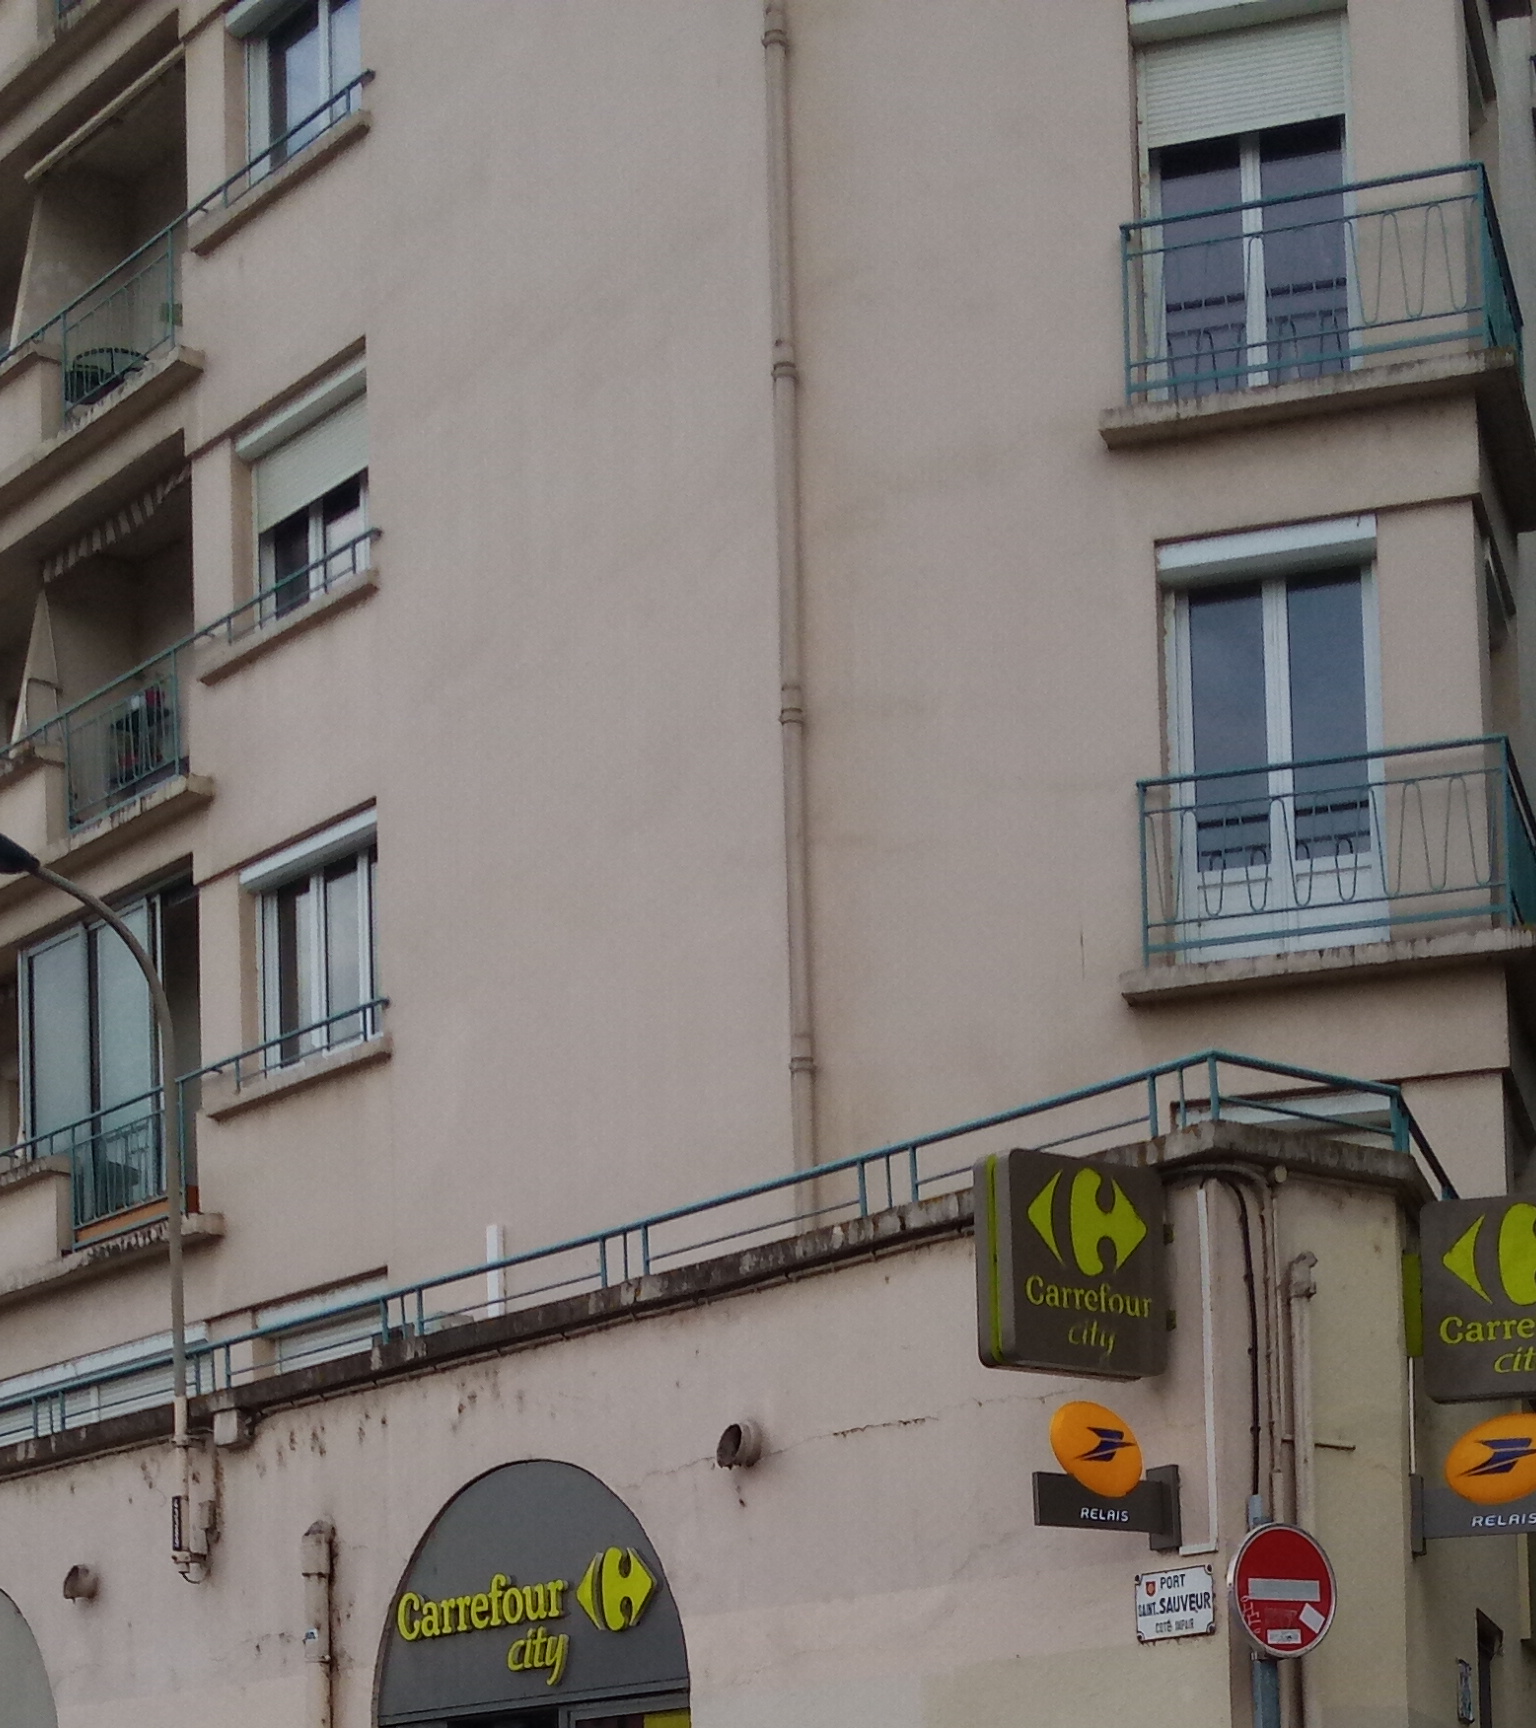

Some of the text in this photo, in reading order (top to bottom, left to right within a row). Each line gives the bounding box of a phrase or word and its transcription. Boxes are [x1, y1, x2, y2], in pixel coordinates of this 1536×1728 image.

[1025, 1274, 1153, 1318] Carrefour
[1067, 1318, 1116, 1357] city
[1079, 1506, 1130, 1523] RELAIS
[1160, 1573, 1186, 1590] PORT
[397, 1572, 569, 1642] Carrefour
[506, 1625, 571, 1687] city
